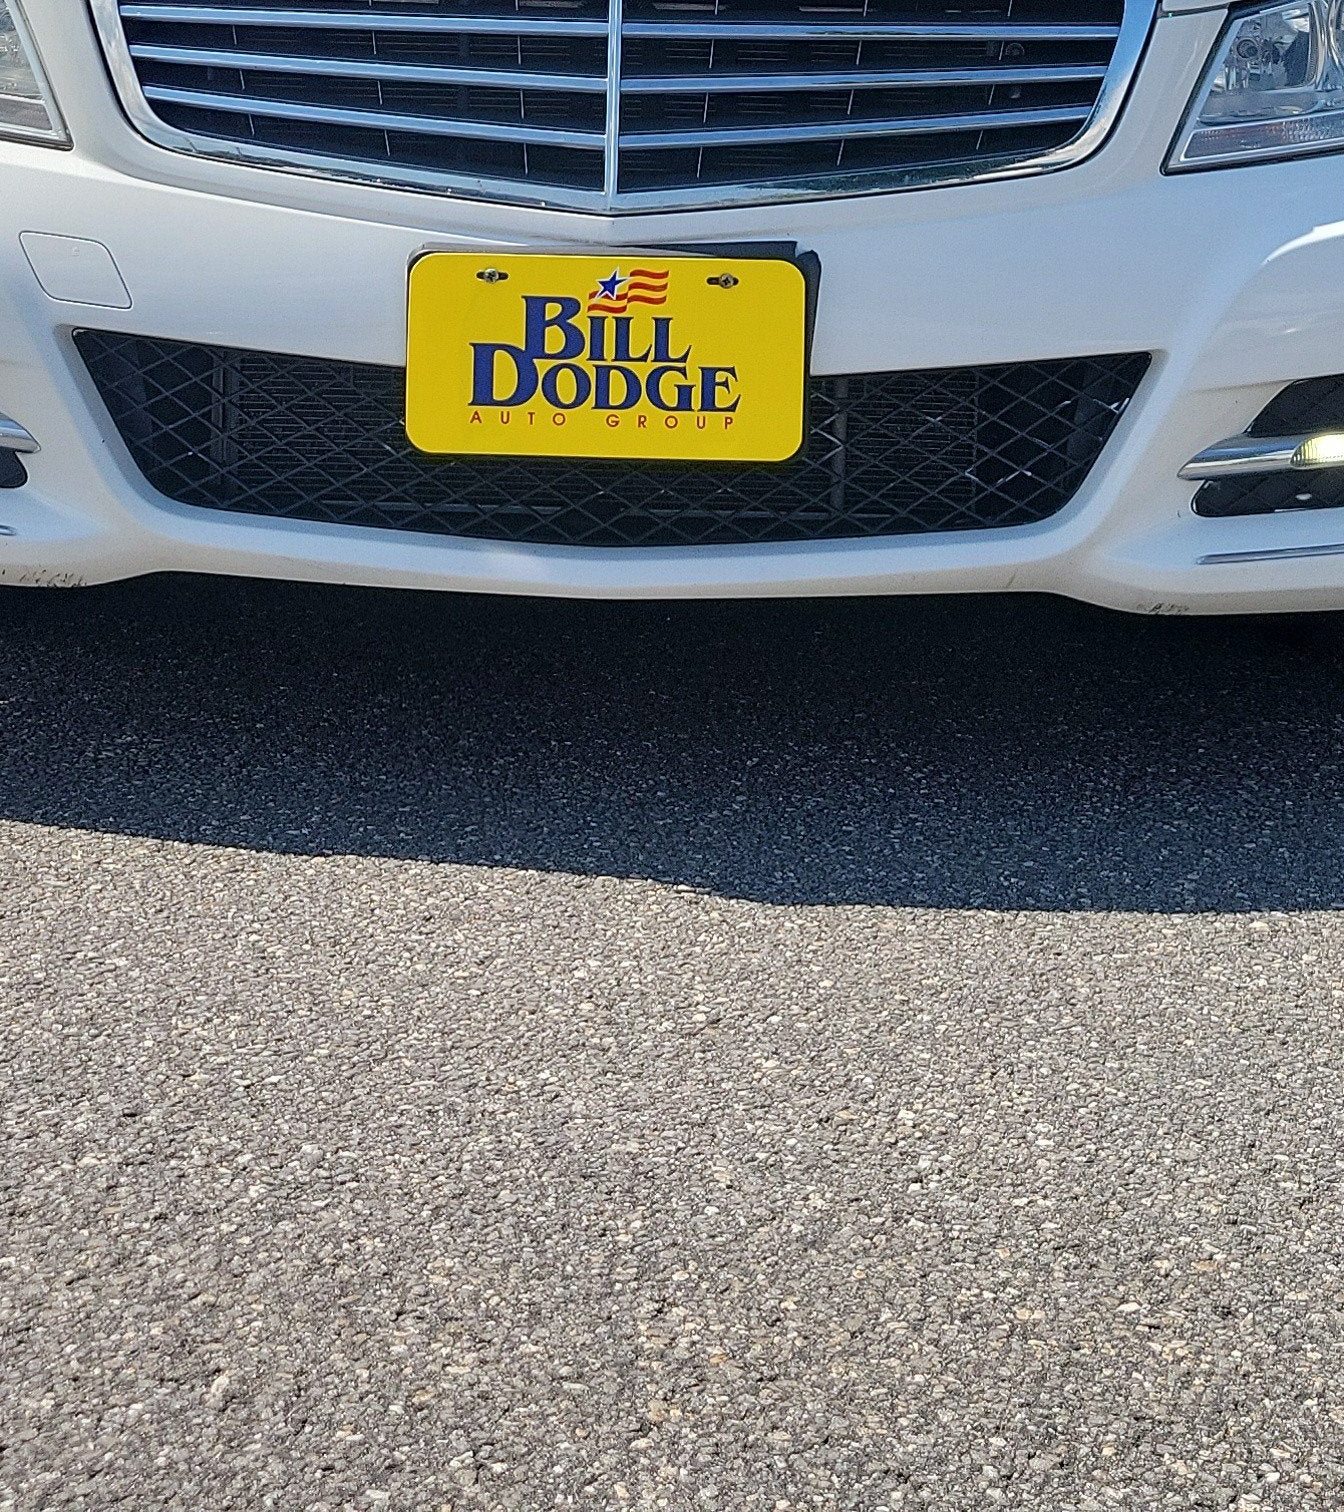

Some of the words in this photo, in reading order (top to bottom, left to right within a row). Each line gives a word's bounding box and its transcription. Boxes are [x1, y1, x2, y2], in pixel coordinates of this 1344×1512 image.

[521, 295, 692, 363] BILL
[468, 342, 741, 413] DODGE
[469, 411, 567, 426] AUTO
[605, 414, 734, 430] GROUP
